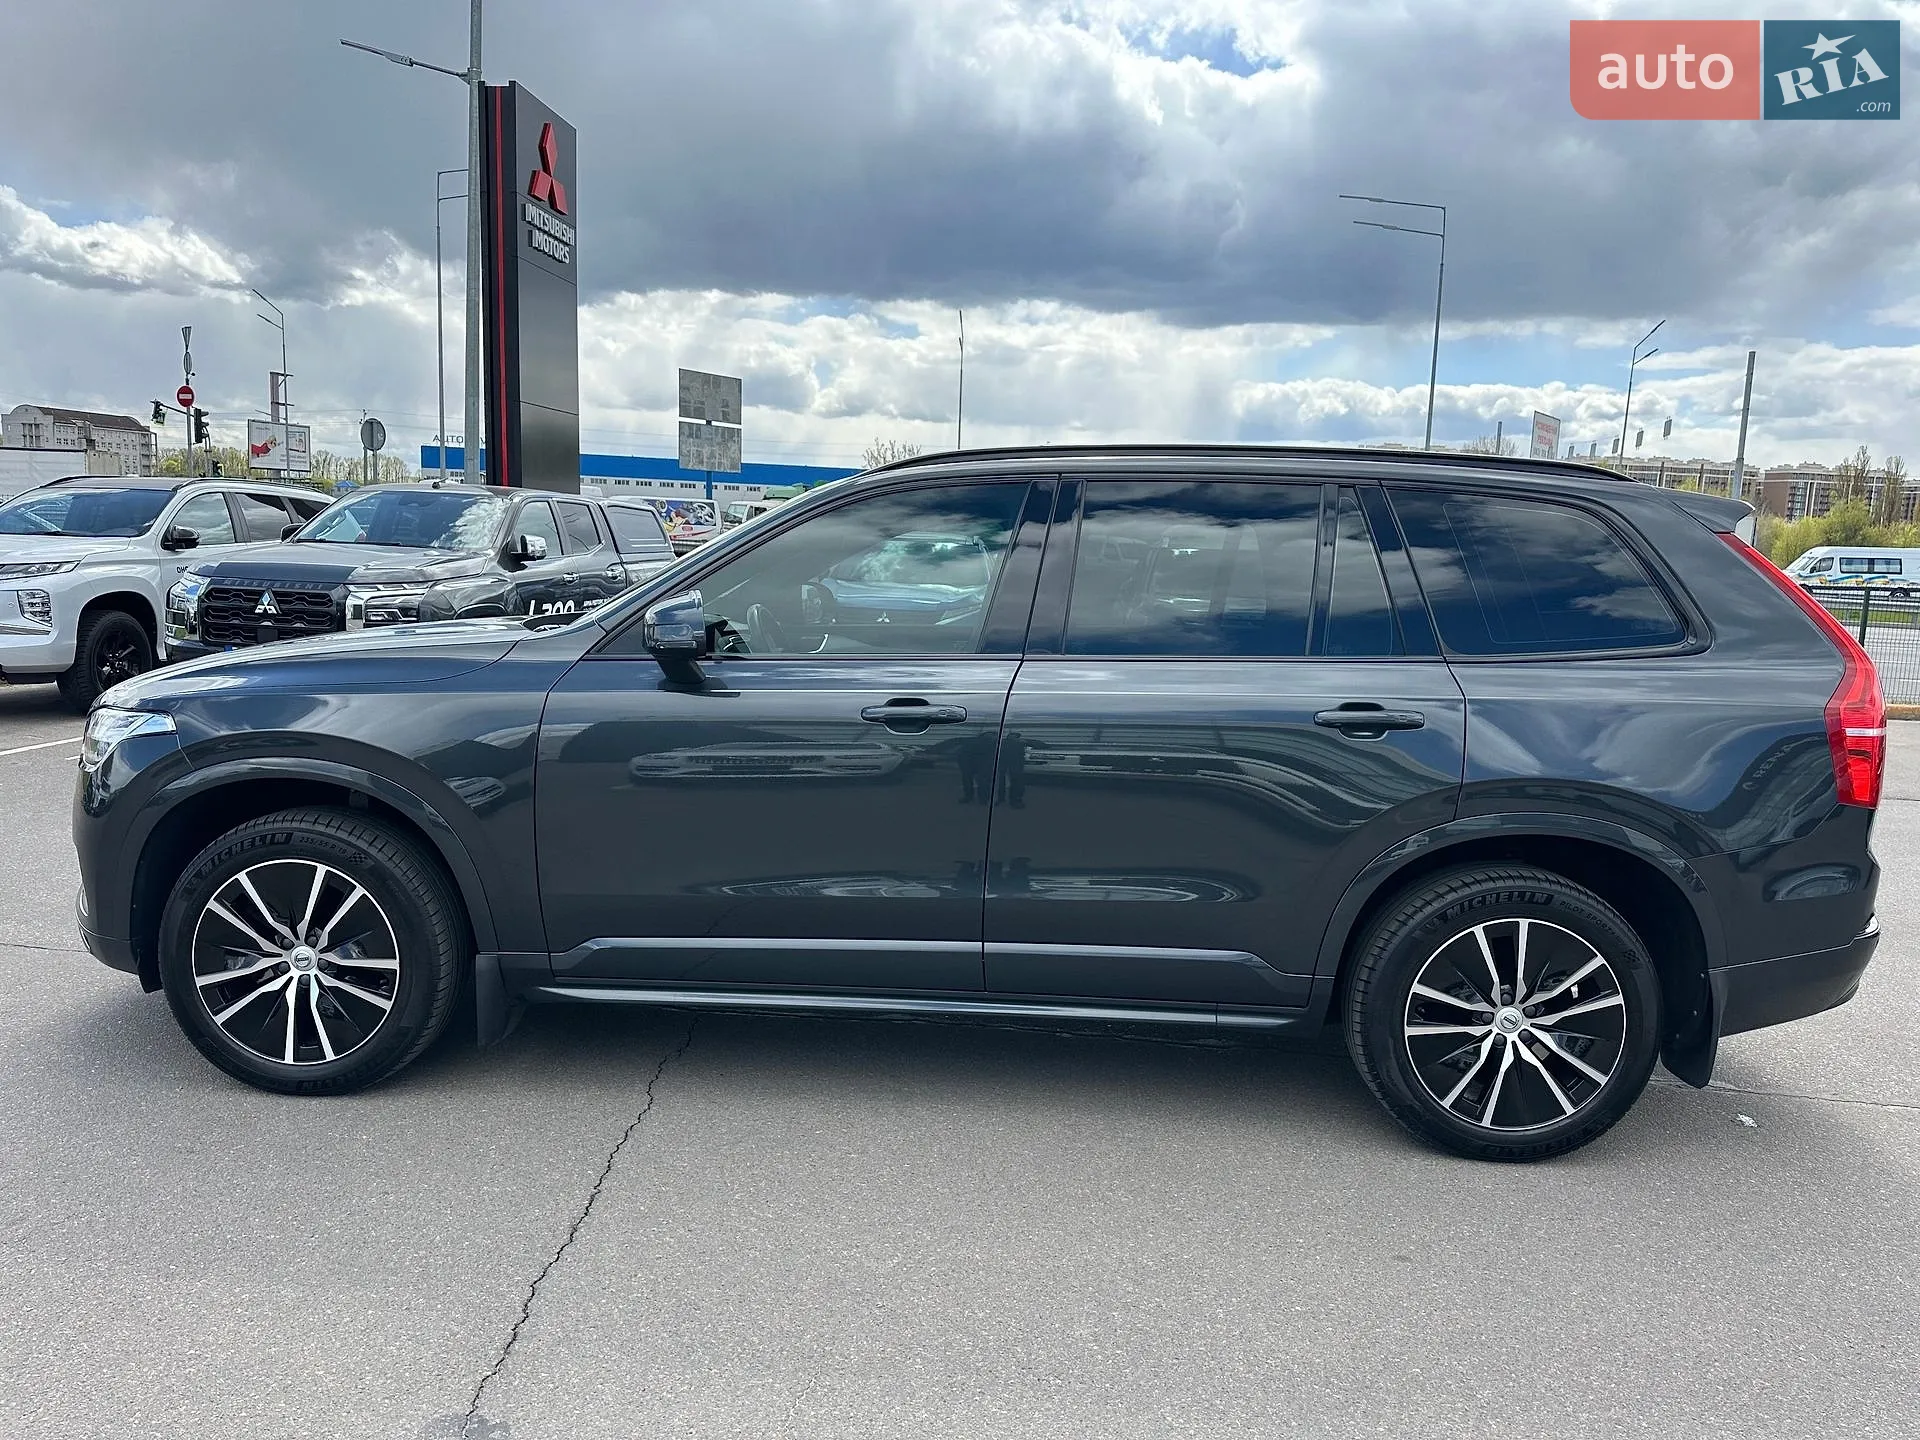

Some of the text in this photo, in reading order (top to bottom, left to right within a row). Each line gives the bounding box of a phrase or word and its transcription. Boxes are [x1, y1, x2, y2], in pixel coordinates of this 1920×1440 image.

[523, 203, 575, 246] MITSUBISHI
[531, 229, 570, 264] MOTORS
[223, 578, 323, 590] MITSUBISHI
[202, 833, 288, 876] MICHELIN
[1447, 891, 1549, 919] MICHELIN
[1559, 900, 1585, 914] PILOT
